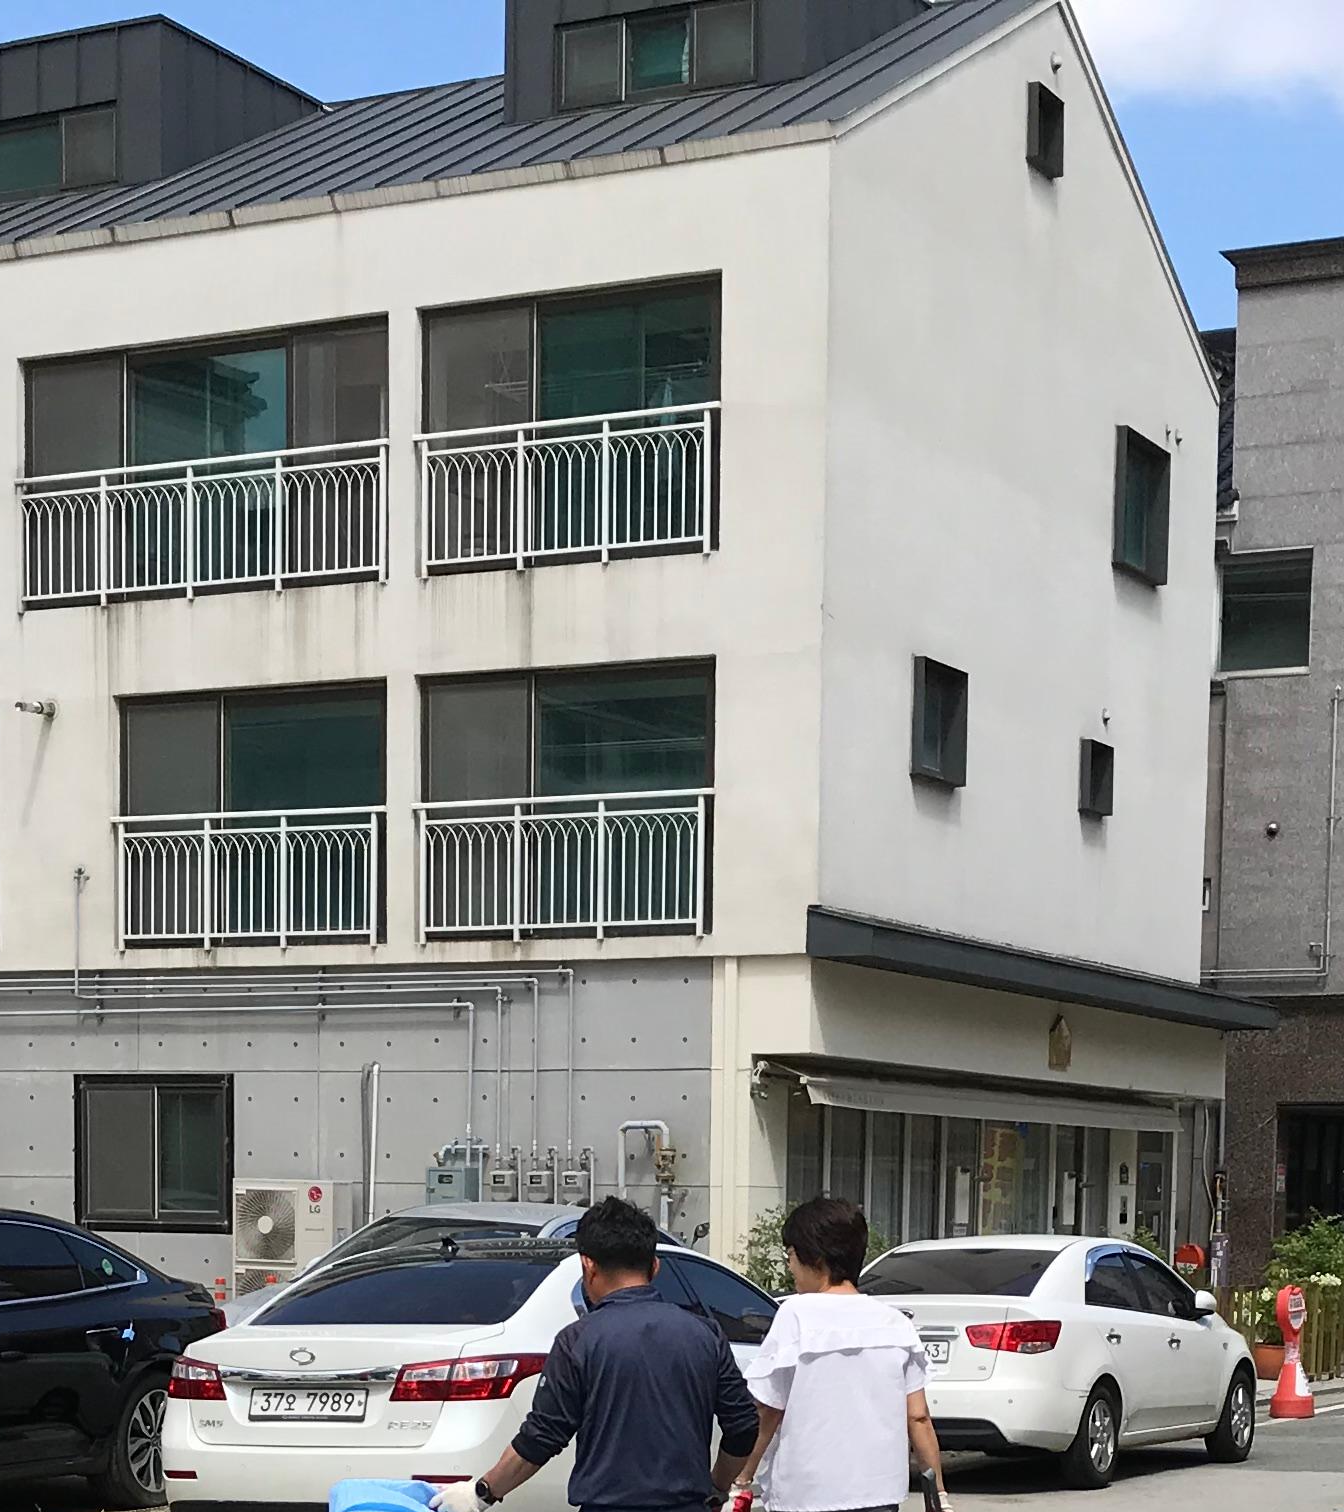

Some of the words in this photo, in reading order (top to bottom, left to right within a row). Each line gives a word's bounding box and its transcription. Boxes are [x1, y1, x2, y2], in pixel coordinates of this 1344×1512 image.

[309, 1204, 321, 1214] LG
[260, 1392, 297, 1412] 37오
[306, 1392, 355, 1413] 7989
[198, 1420, 224, 1428] SM5
